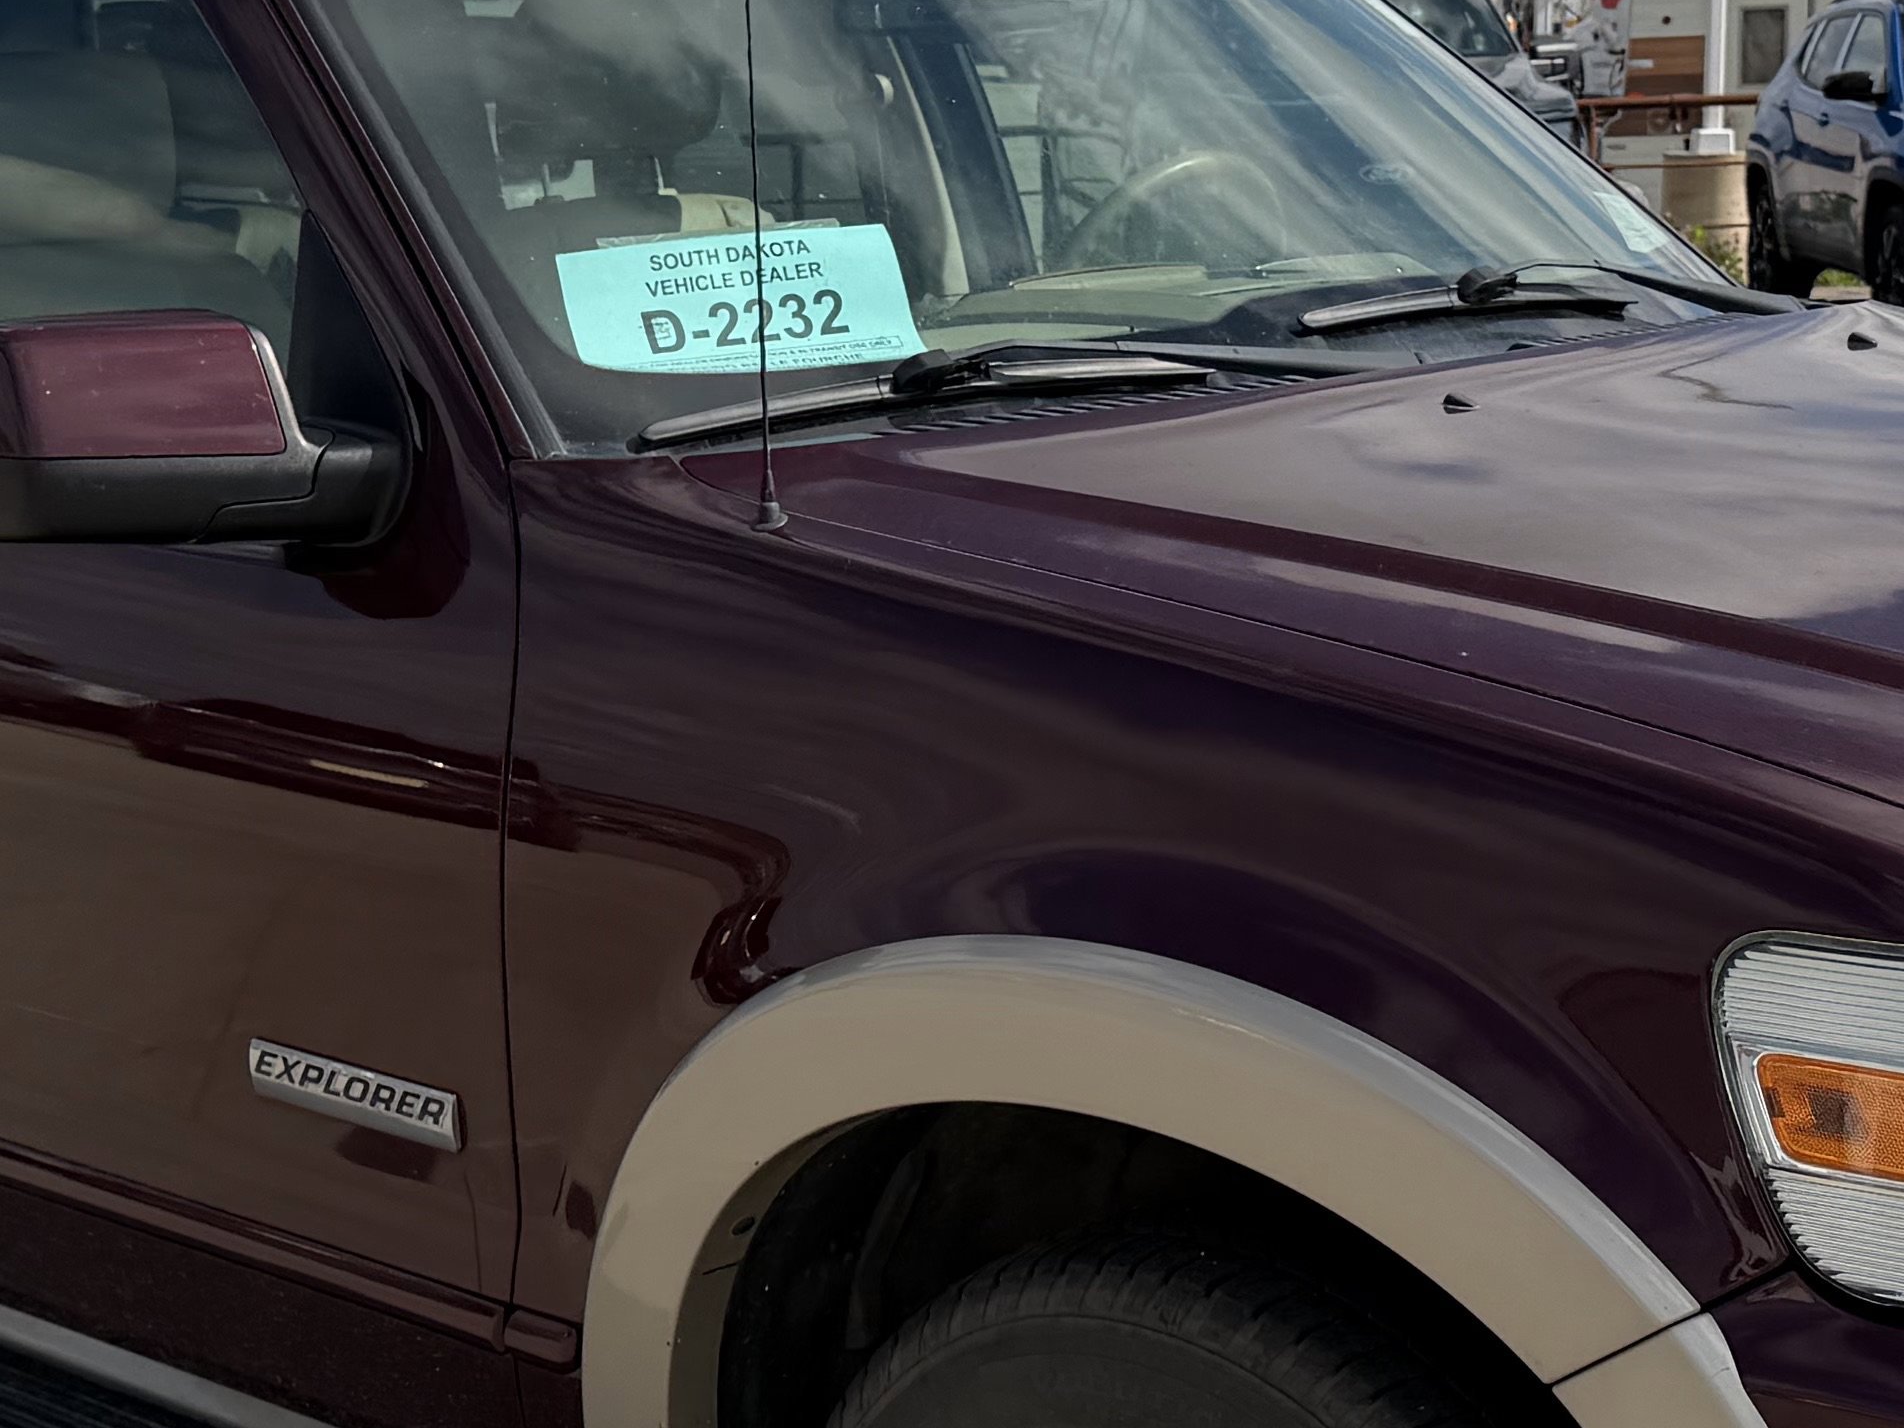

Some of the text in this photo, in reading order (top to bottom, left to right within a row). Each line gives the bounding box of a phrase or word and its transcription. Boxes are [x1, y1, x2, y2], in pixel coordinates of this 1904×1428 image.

[646, 262, 824, 297] VEHICLE DEALER
[649, 239, 811, 271] SOUTH DAKOTA
[640, 288, 851, 354] D-2232
[254, 1049, 446, 1126] EXPLORER
